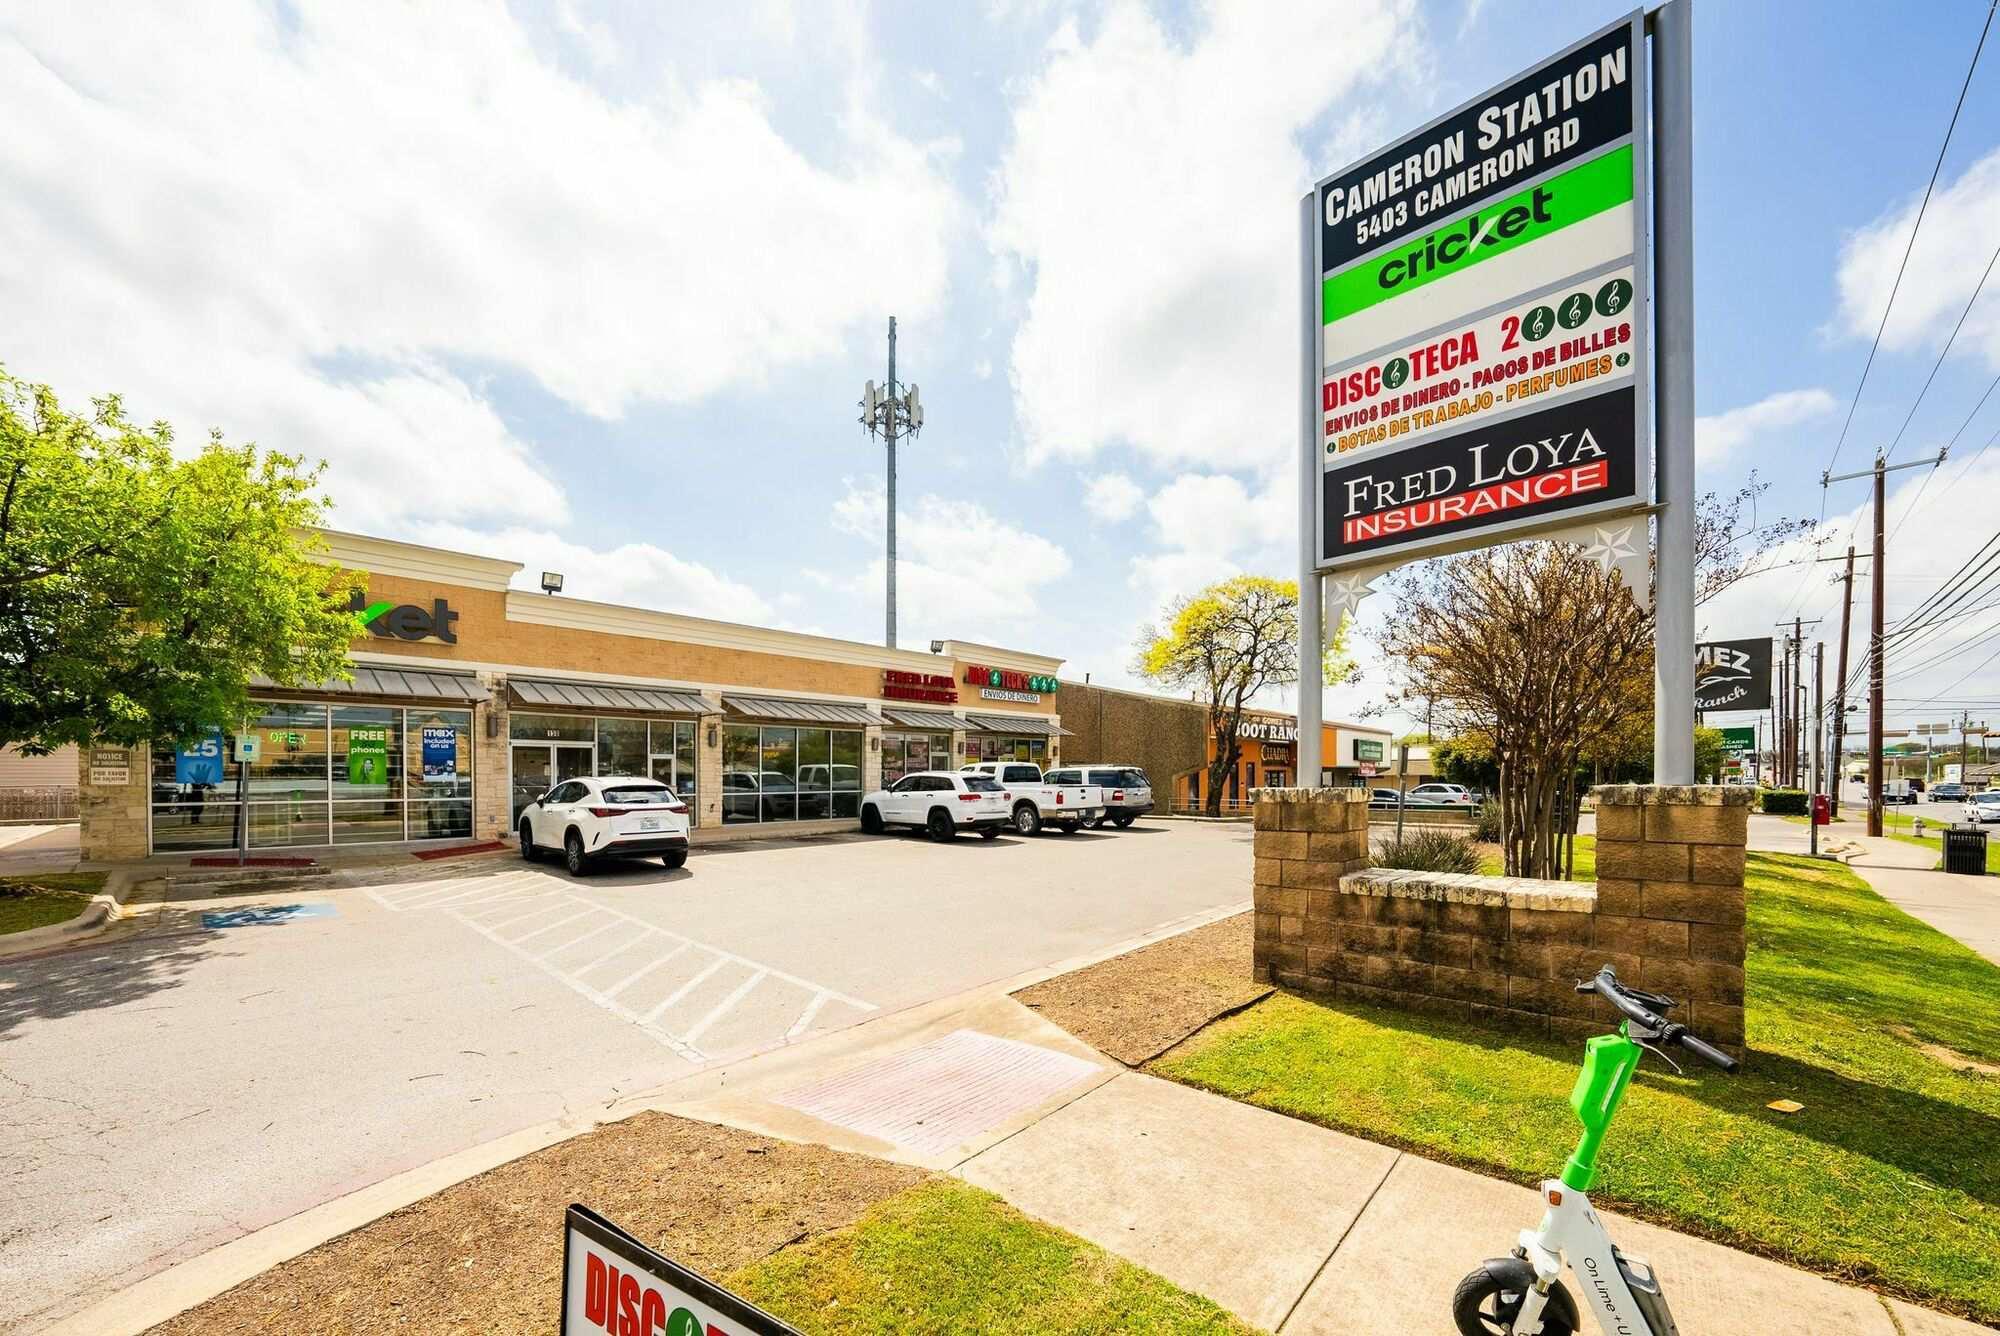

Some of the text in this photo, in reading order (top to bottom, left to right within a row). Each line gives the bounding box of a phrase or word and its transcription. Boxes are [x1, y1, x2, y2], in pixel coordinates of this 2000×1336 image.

[1356, 117, 1580, 246] 5403 CAMERON RD
[1378, 186, 1553, 289] cricket
[1325, 404, 1378, 436] ENVIOS
[1381, 398, 1400, 418] DE
[1402, 382, 1460, 412] DINERO
[1472, 357, 1528, 387] PAGOS
[1532, 348, 1556, 369] DE
[1560, 322, 1631, 362] BILLES
[1338, 428, 1386, 453] BOTAS
[1390, 420, 1409, 437] DE
[1413, 391, 1493, 429] TRABAJO
[1506, 354, 1613, 402] PERFUMES
[1347, 465, 1603, 543] INSURANCE
[1695, 646, 1750, 673] MEZ
[983, 689, 1039, 703] ENVIOS DE DINERO
[350, 730, 385, 741] FREE
[350, 746, 385, 754] phones
[424, 729, 454, 737] max
[1269, 725, 1299, 740] RANC
[1584, 1257, 1599, 1277] On
[1593, 1280, 1616, 1312] Lime
